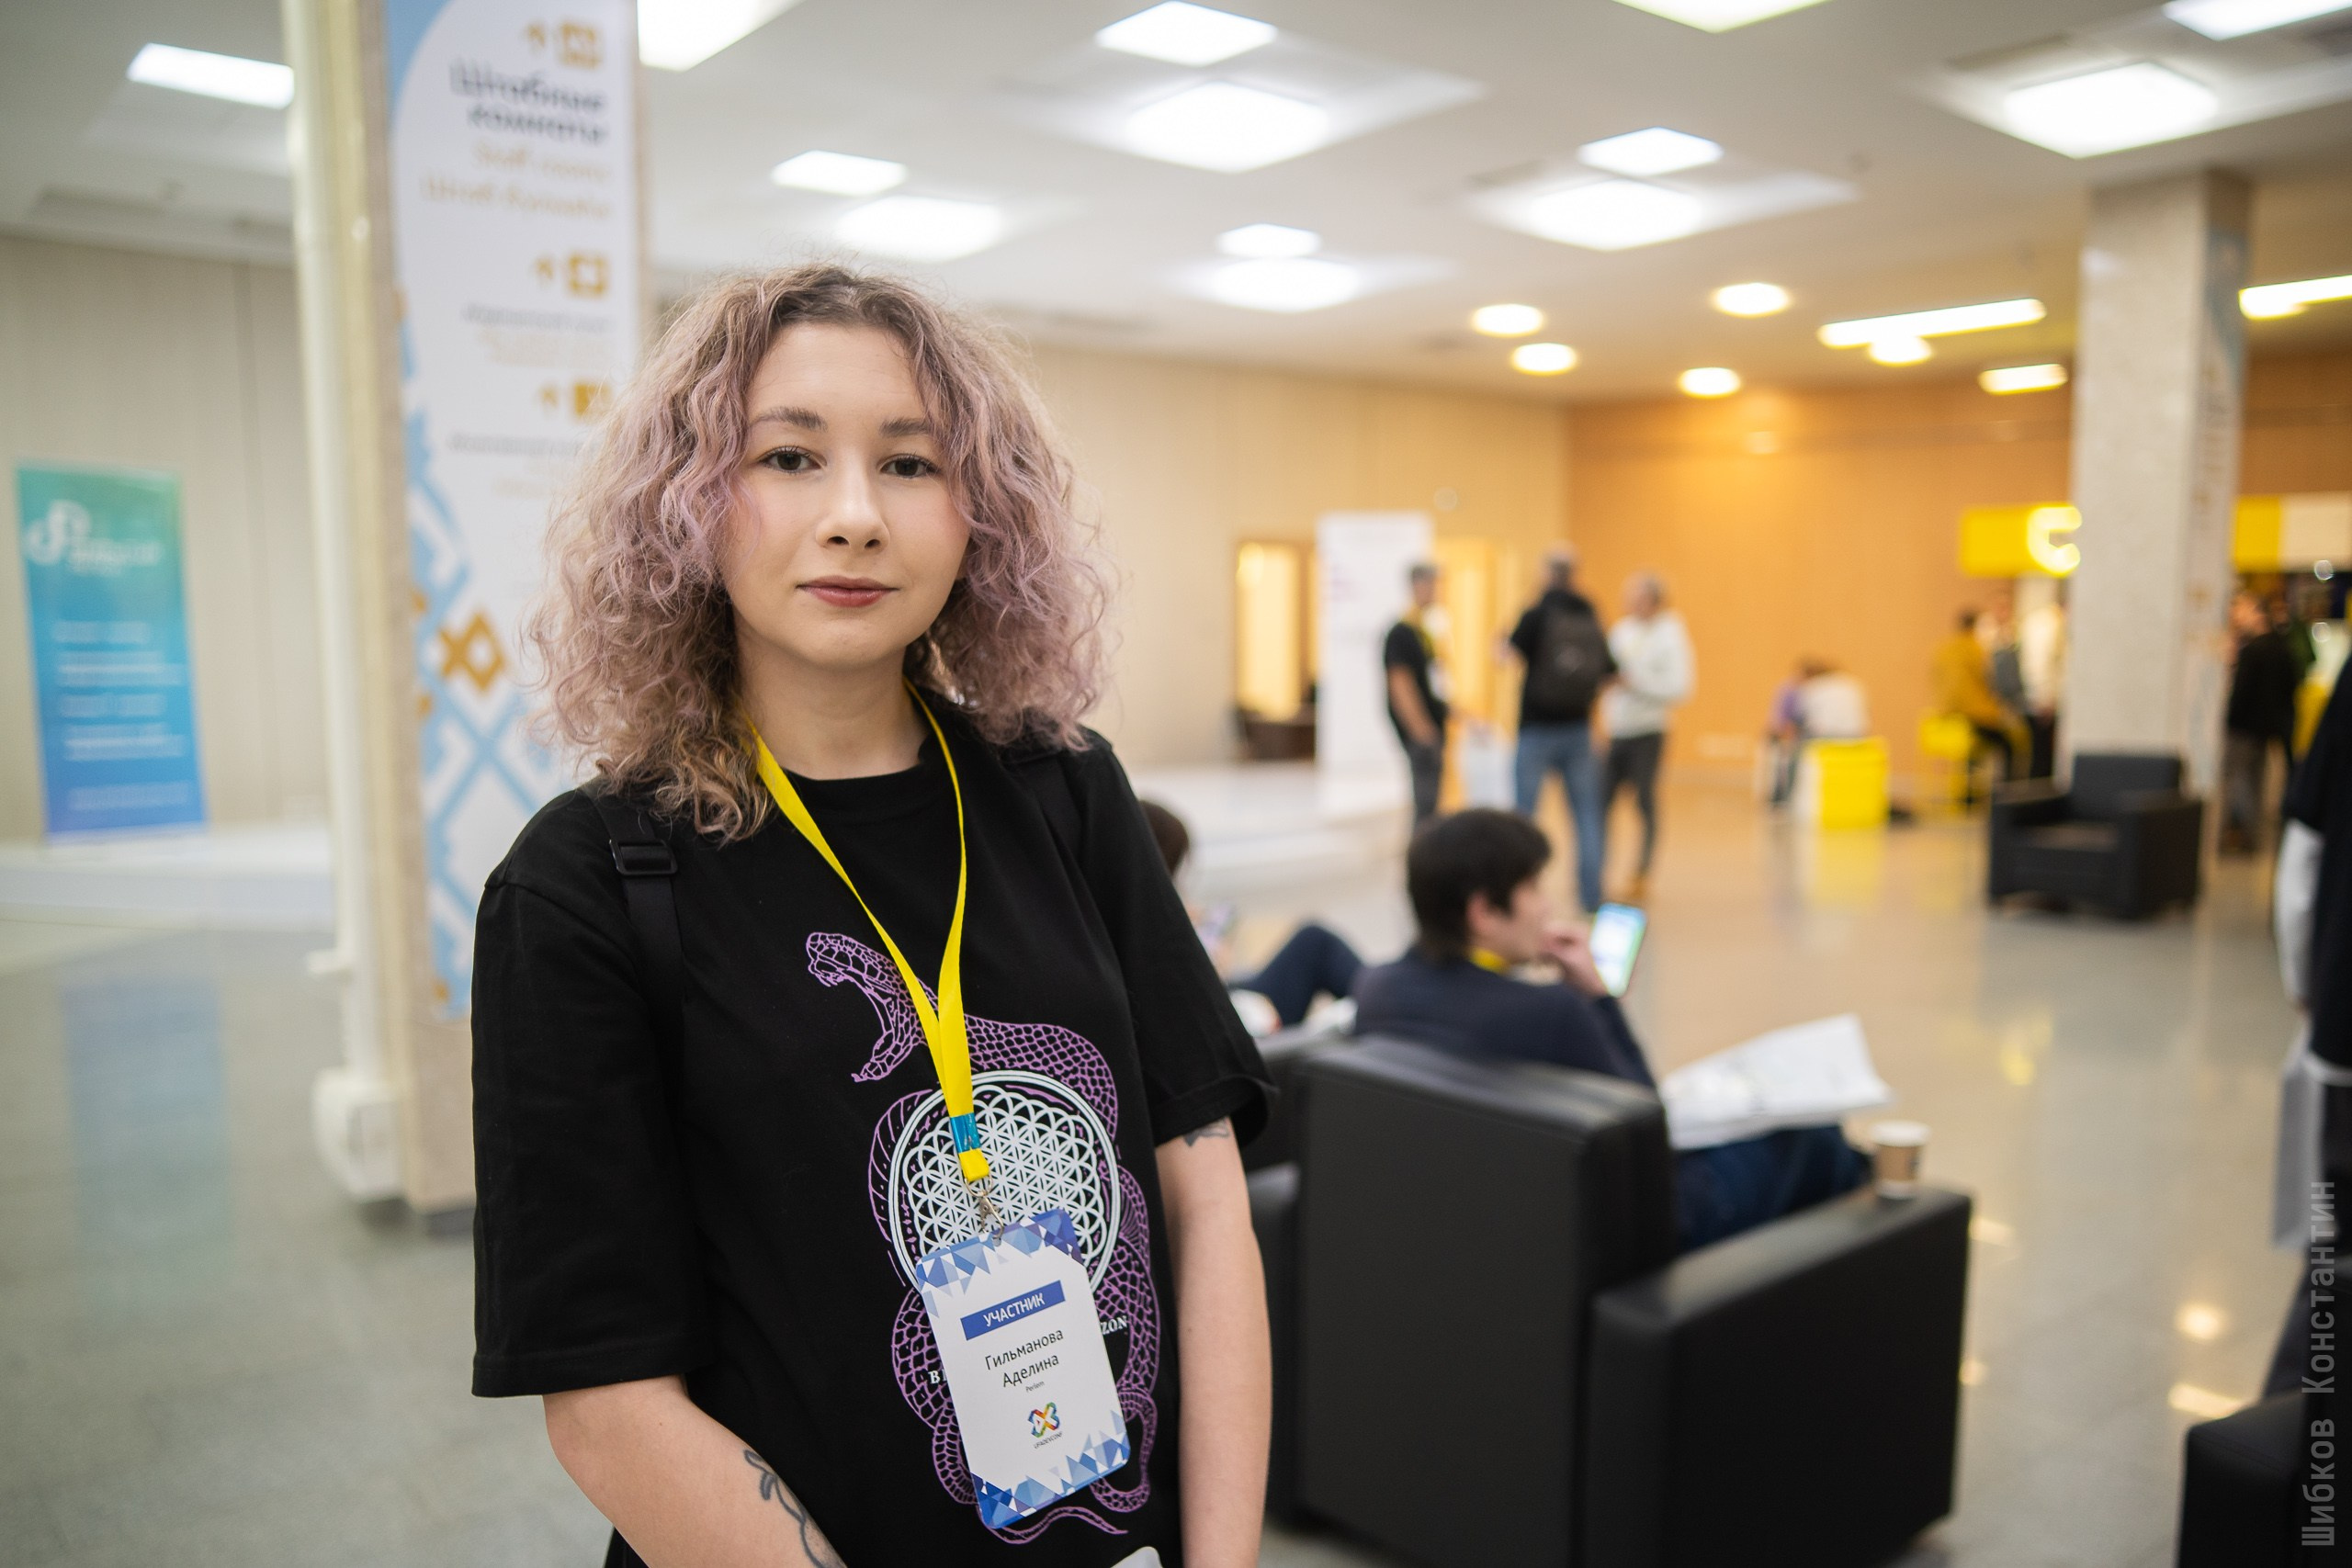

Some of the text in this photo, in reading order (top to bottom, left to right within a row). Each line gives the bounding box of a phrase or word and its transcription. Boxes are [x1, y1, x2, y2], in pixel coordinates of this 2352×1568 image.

[983, 1292, 1046, 1327] УЧАСТНИК
[985, 1329, 1064, 1371] Гильманова
[1002, 1354, 1059, 1388] Аделина
